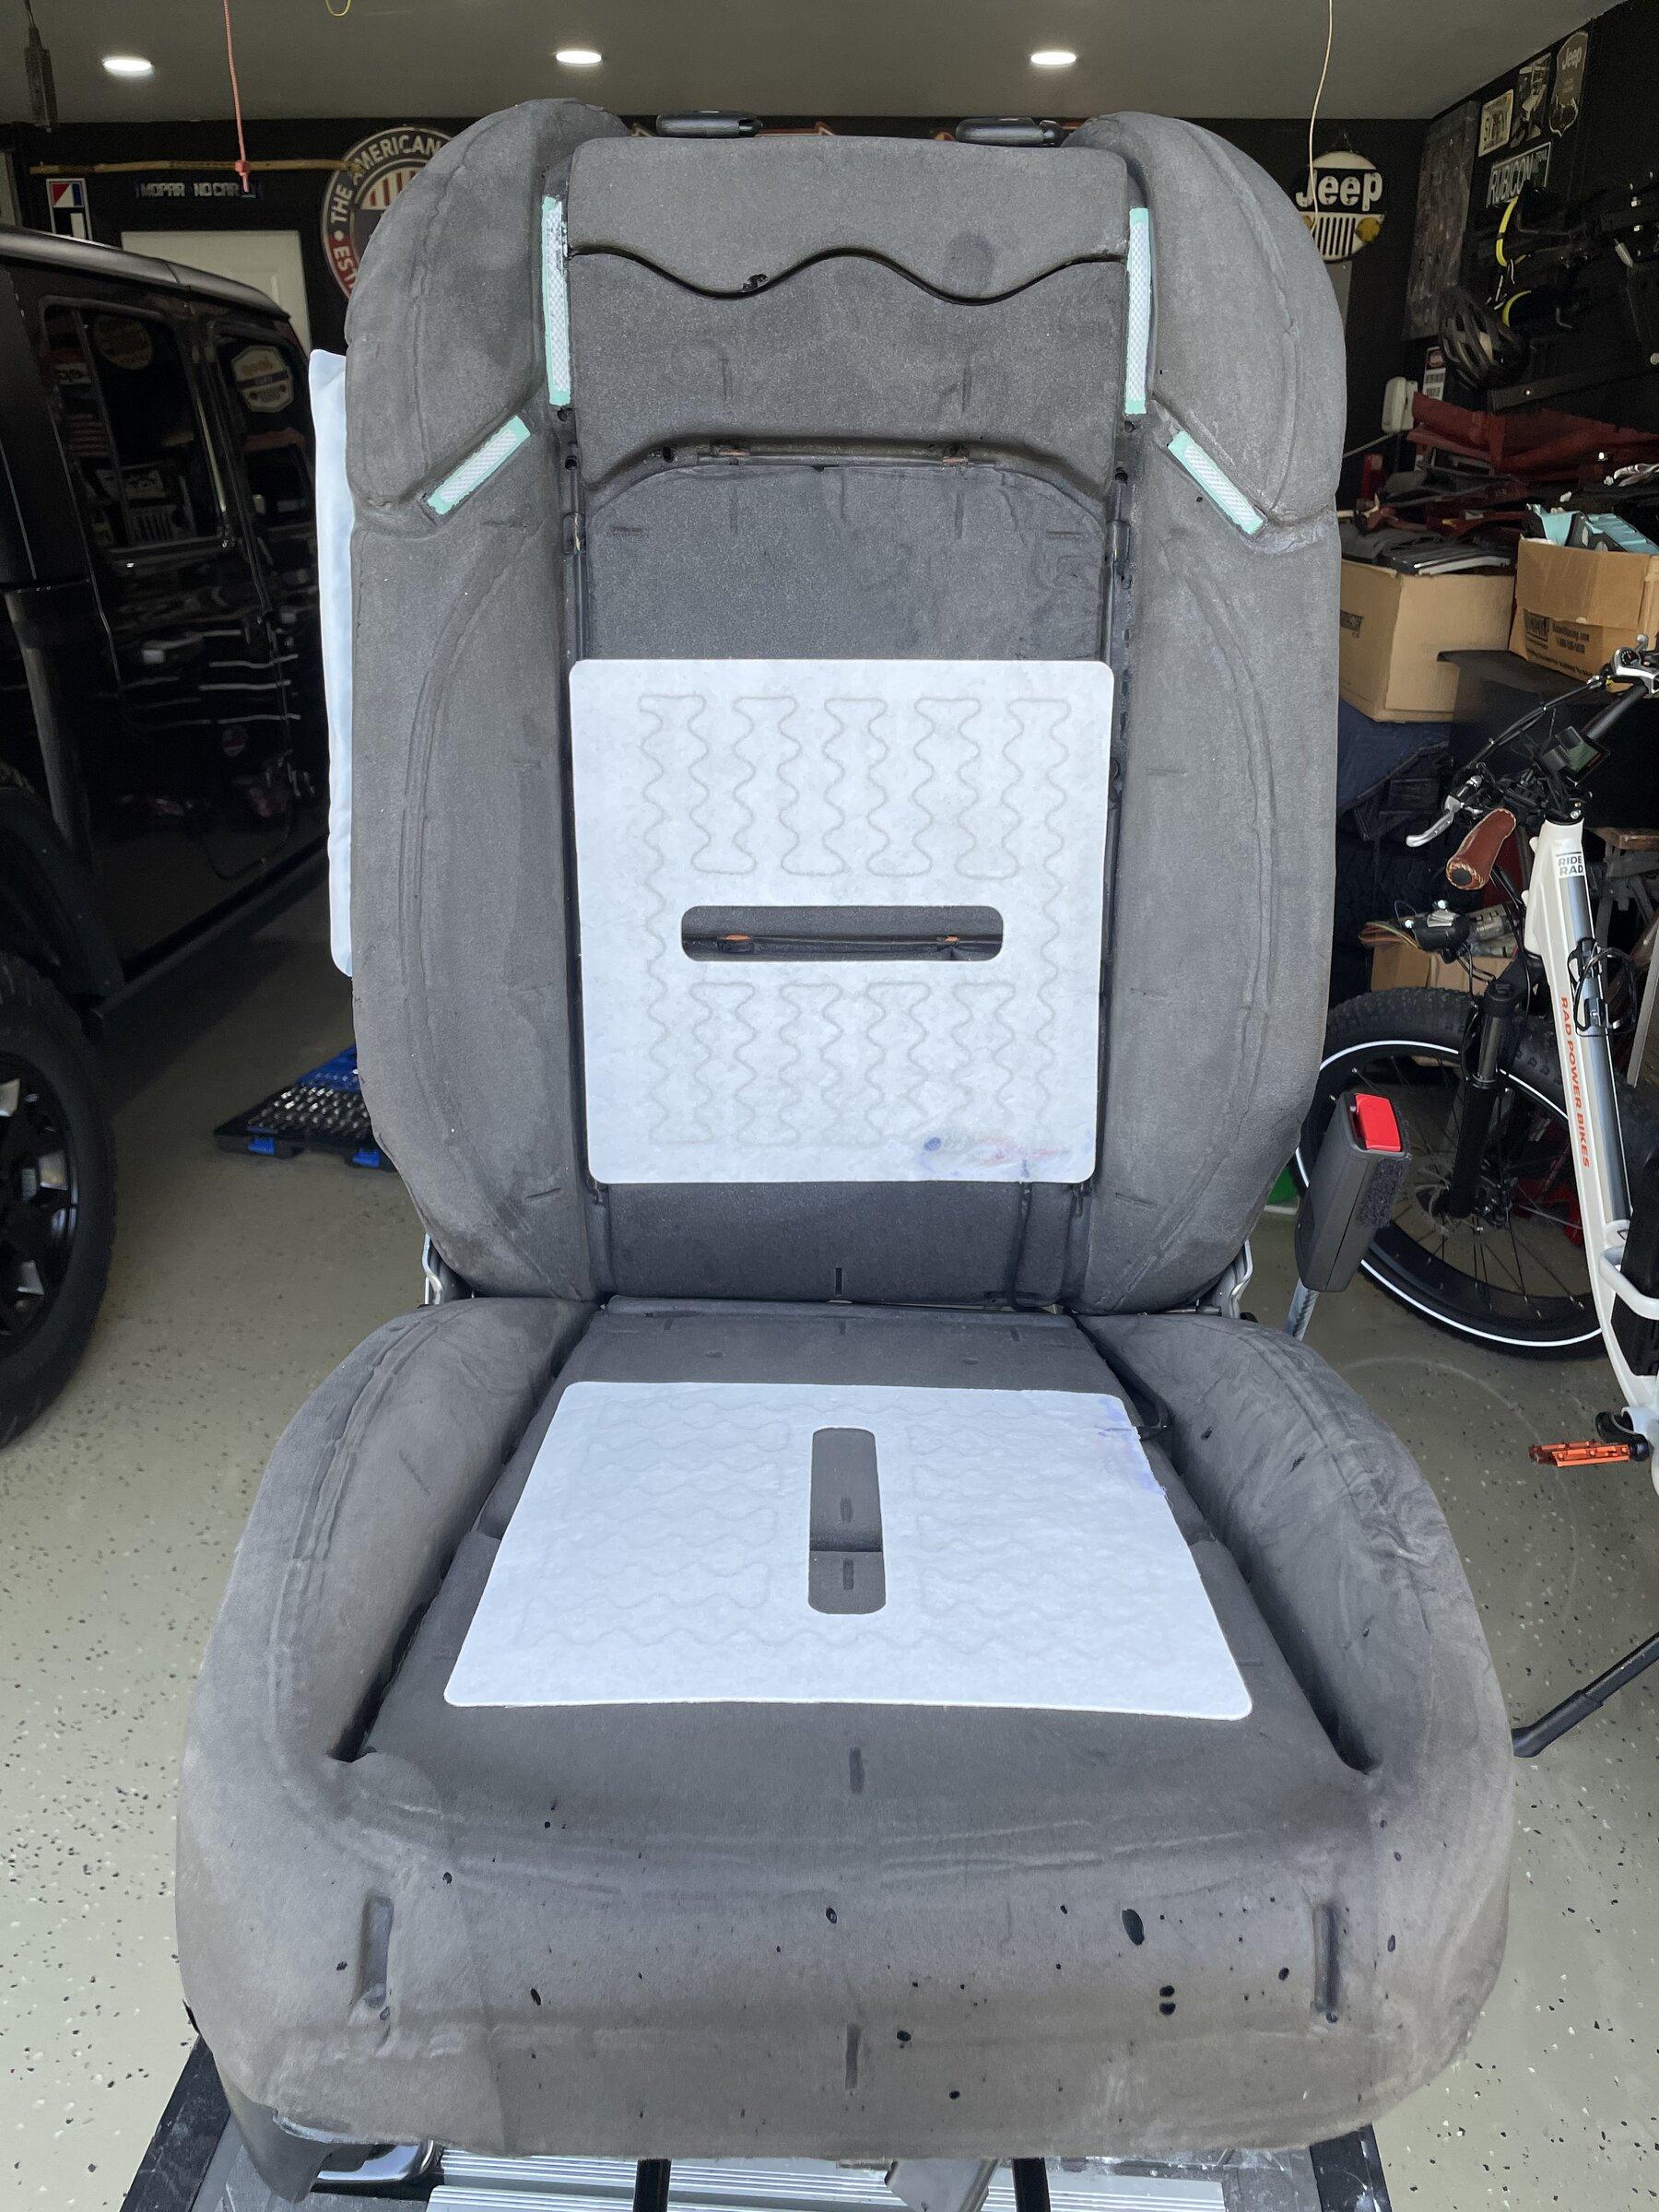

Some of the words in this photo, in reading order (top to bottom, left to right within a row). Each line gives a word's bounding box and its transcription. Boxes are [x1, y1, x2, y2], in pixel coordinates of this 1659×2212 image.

[1562, 46, 1583, 70] Jeep
[330, 184, 352, 224] THE
[351, 135, 441, 185] AMERICAN
[1295, 169, 1383, 212] Jeep
[1558, 855, 1583, 866] RIDE
[1559, 865, 1584, 877] RAD
[1561, 996, 1572, 1036] RAD
[1567, 1041, 1582, 1109] POWER
[1576, 1112, 1590, 1169] BIKES
